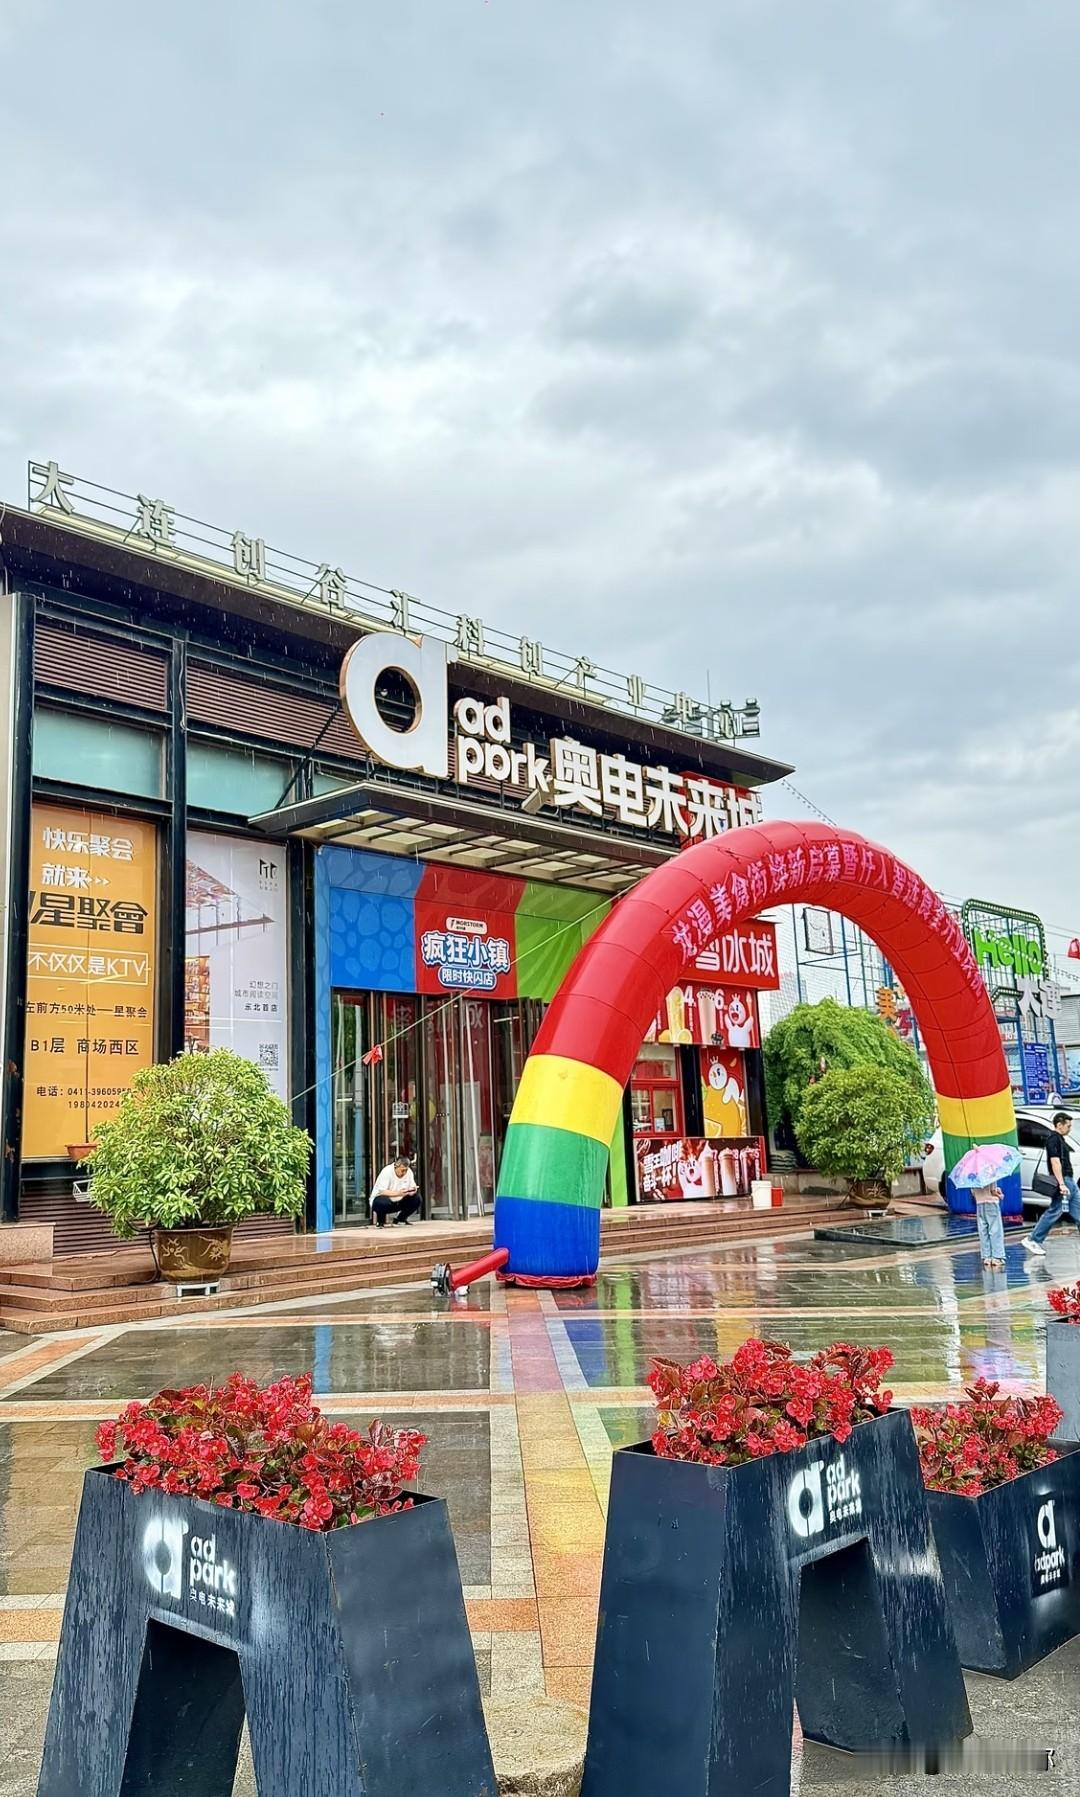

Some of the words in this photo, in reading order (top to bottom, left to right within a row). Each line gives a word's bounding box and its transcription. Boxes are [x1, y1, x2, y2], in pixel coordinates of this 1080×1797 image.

[454, 697, 511, 743] ad
[550, 735, 764, 840] 奥电未来城
[42, 826, 134, 861] 快乐聚会
[41, 863, 89, 889] 就来
[28, 952, 146, 977] 不仅仅是KTV
[422, 932, 509, 969] 疯狂小镇
[973, 927, 1045, 976] Hello
[441, 968, 494, 986] 限时快闪店
[31, 1037, 65, 1054] B1层
[77, 1038, 140, 1056] 商场西区
[827, 1468, 861, 1511] park
[190, 1533, 216, 1563] ad
[189, 1556, 236, 1596] park
